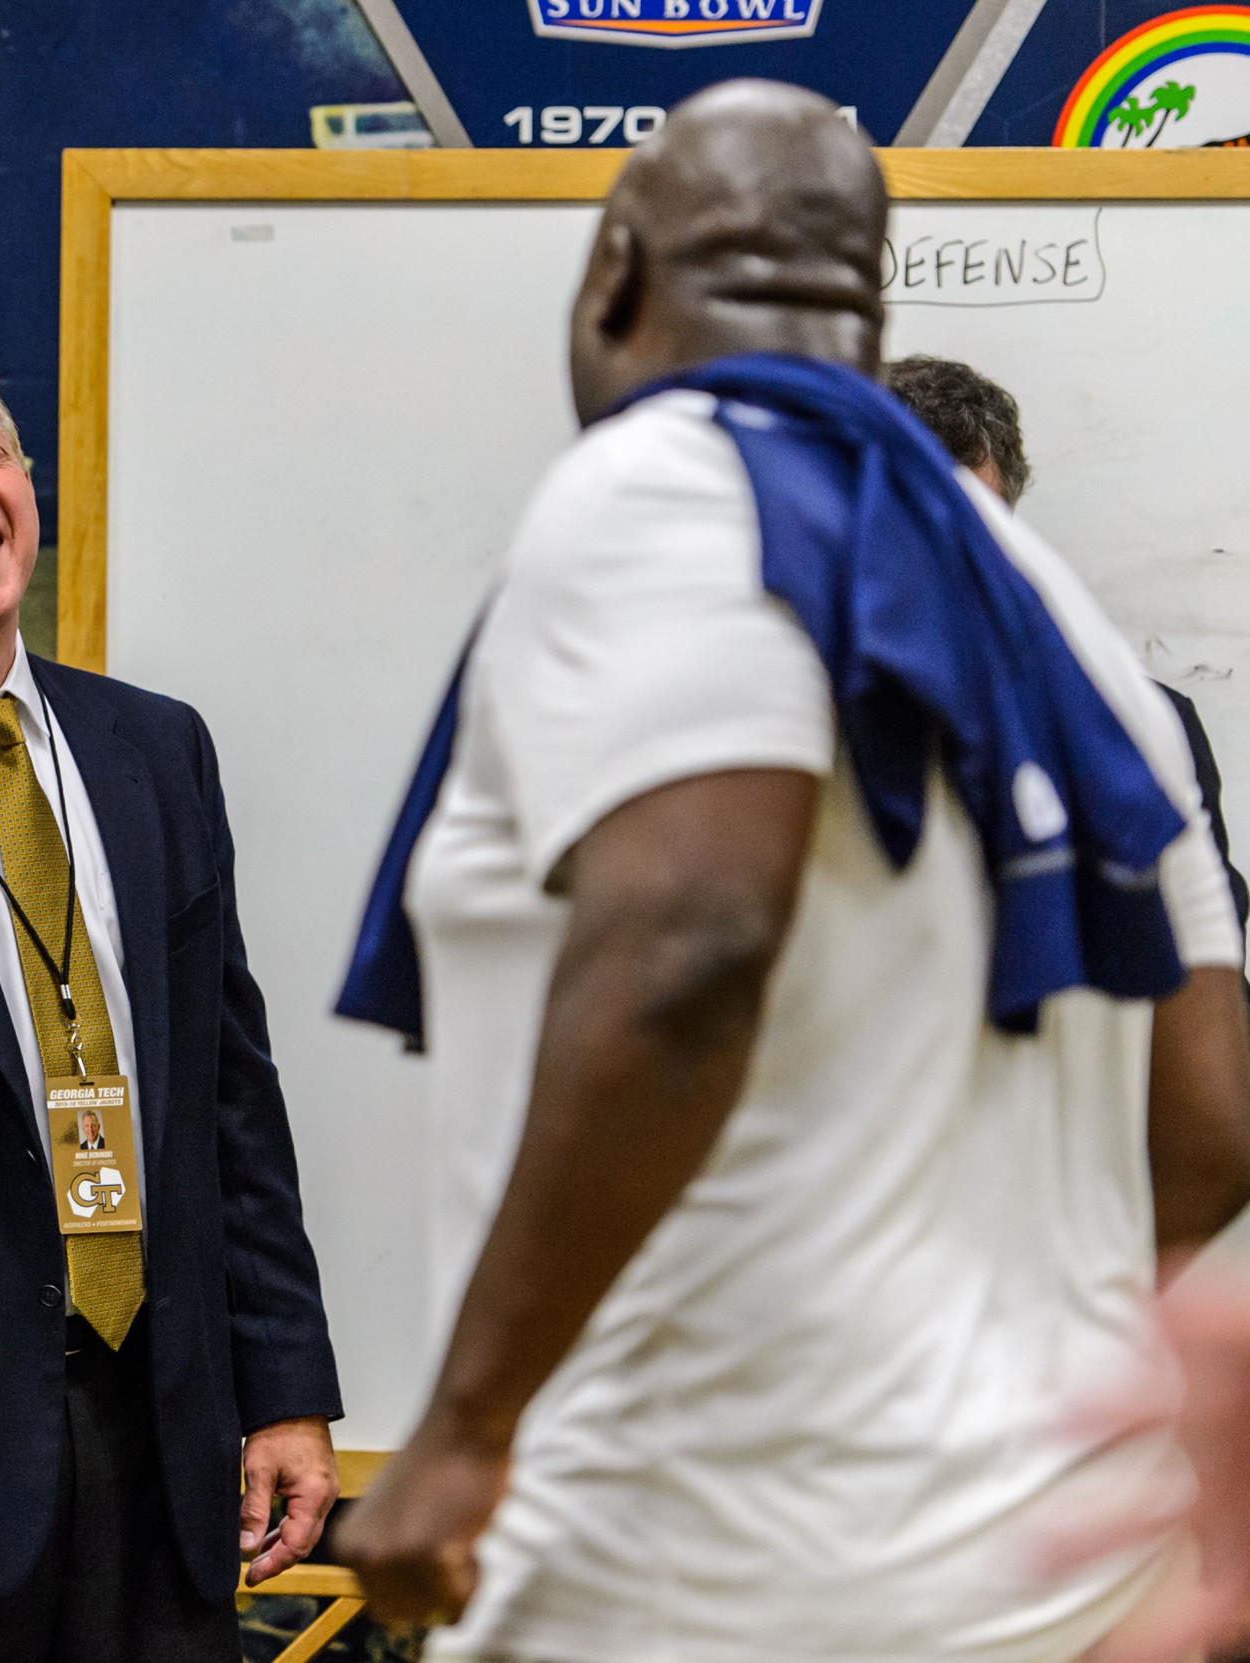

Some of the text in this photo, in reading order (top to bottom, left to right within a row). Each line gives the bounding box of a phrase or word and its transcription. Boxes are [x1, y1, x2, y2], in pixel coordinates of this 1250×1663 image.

[547, 0, 806, 20] SUN BOWL
[503, 106, 667, 144] 1970
[50, 1086, 125, 1100] GEORGIA TECH
[70, 1171, 123, 1214] GT
